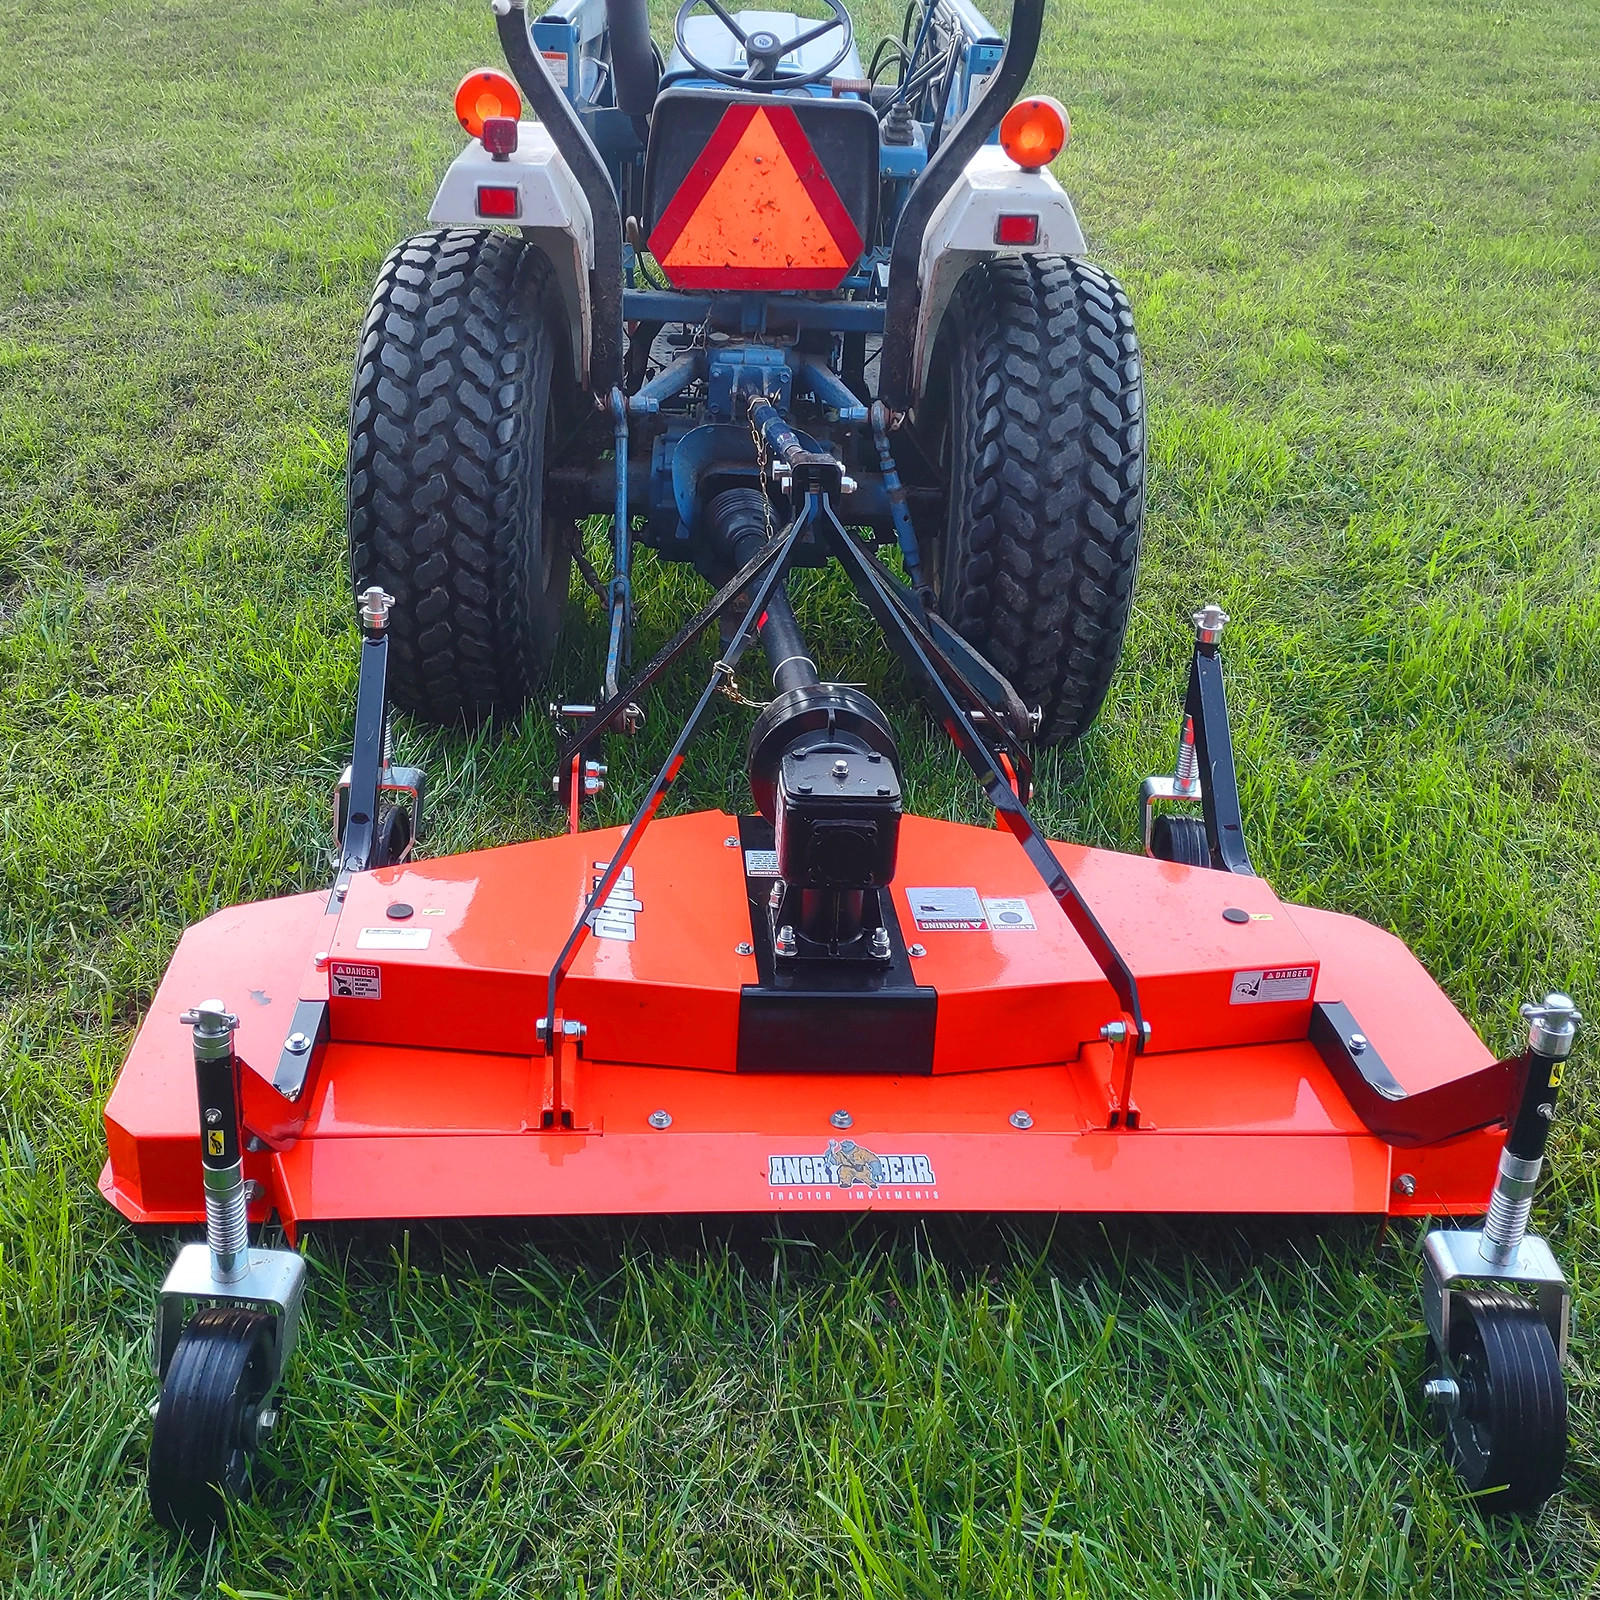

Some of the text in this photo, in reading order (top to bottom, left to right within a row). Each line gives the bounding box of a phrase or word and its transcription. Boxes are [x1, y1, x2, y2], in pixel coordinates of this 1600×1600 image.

[921, 921, 967, 930] WARNING
[345, 966, 376, 977] DANGER
[1275, 970, 1308, 979] DANGER
[770, 1155, 935, 1184] ANGRY BEAR
[769, 1190, 939, 1201] TRACTOR IMPLEMENTS
